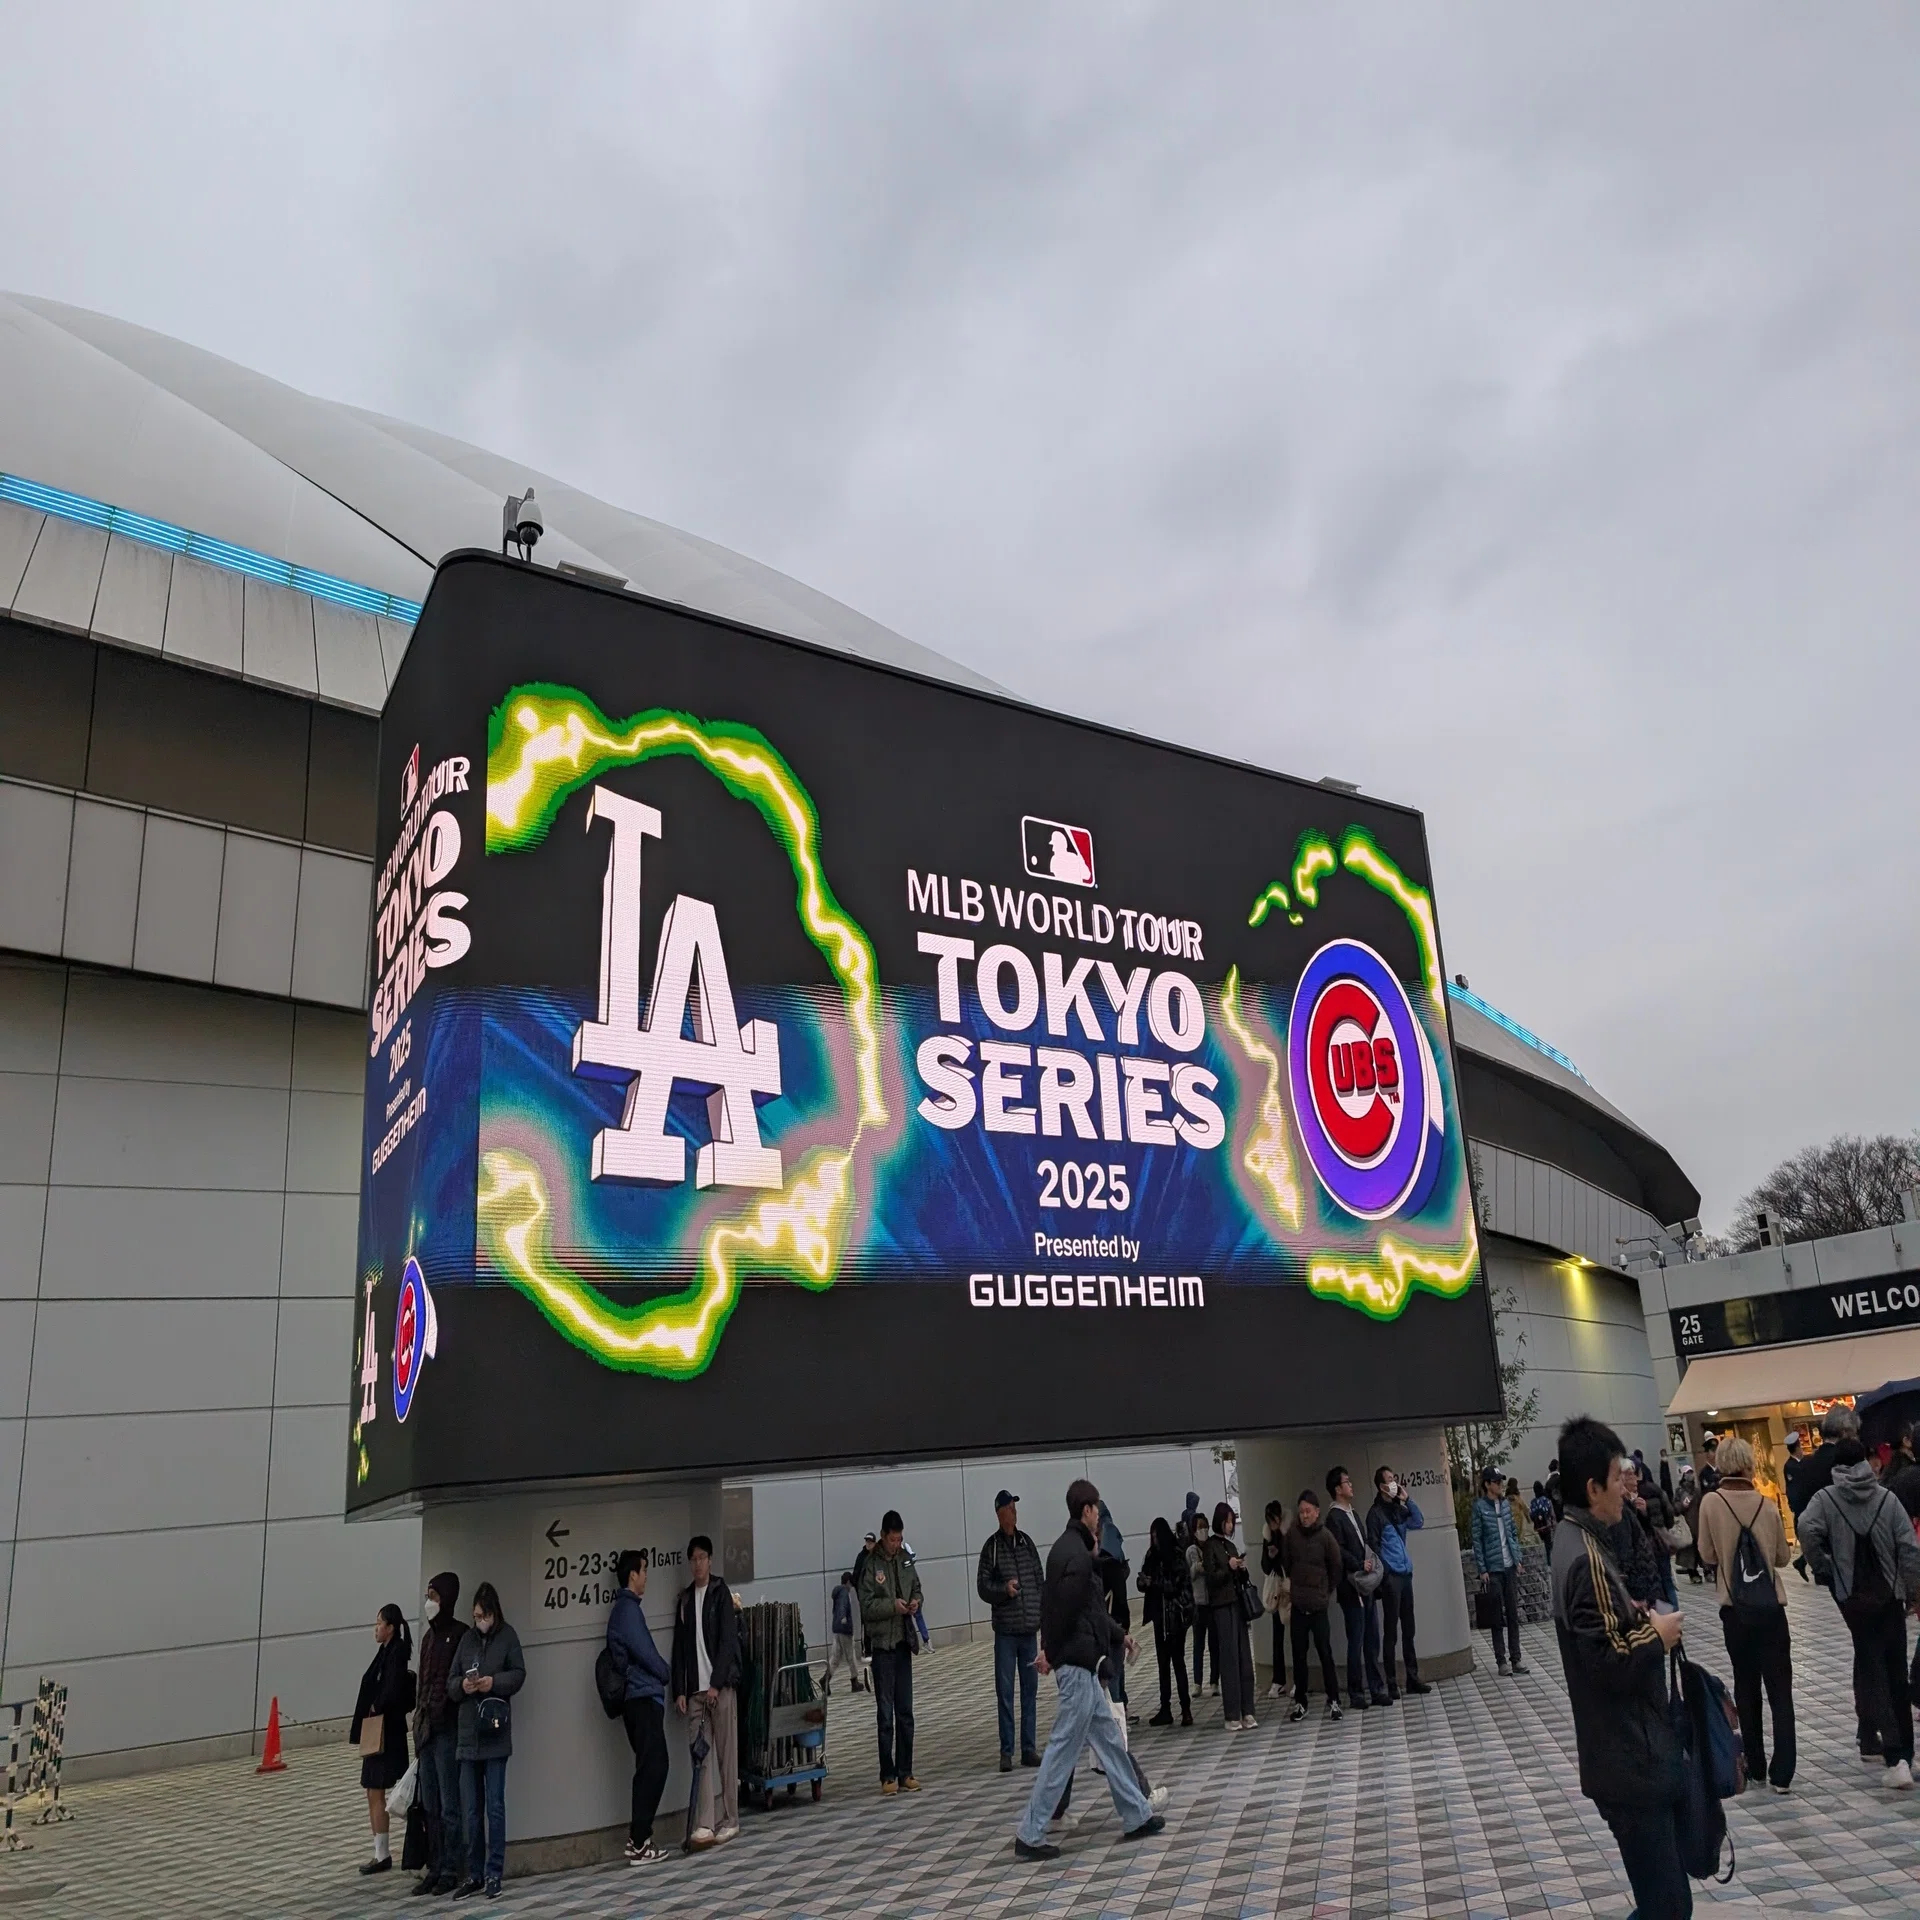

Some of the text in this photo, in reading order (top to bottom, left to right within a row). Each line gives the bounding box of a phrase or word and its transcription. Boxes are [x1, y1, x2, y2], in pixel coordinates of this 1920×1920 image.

[376, 756, 471, 912] MLB WORLD TOUR
[376, 810, 461, 977] TOKYO
[907, 869, 1205, 961] MLB WORLD TOUR
[370, 890, 472, 1058] SERIES
[571, 784, 783, 1191] LA
[917, 931, 1207, 1052] TOKYO
[388, 1018, 412, 1084] 2025
[916, 1033, 1226, 1150] SERIES
[372, 1086, 427, 1176] GUGGENHEIM
[1036, 1159, 1131, 1211] 2025
[1035, 1231, 1141, 1263] Presented by
[969, 1273, 1205, 1308] GUGGENHEIM
[1831, 1284, 1920, 1319] WELCO
[1679, 1314, 1701, 1336] 25
[1682, 1334, 1704, 1346] GATE
[657, 1551, 682, 1567] GATE
[602, 1590, 618, 1604] GA
